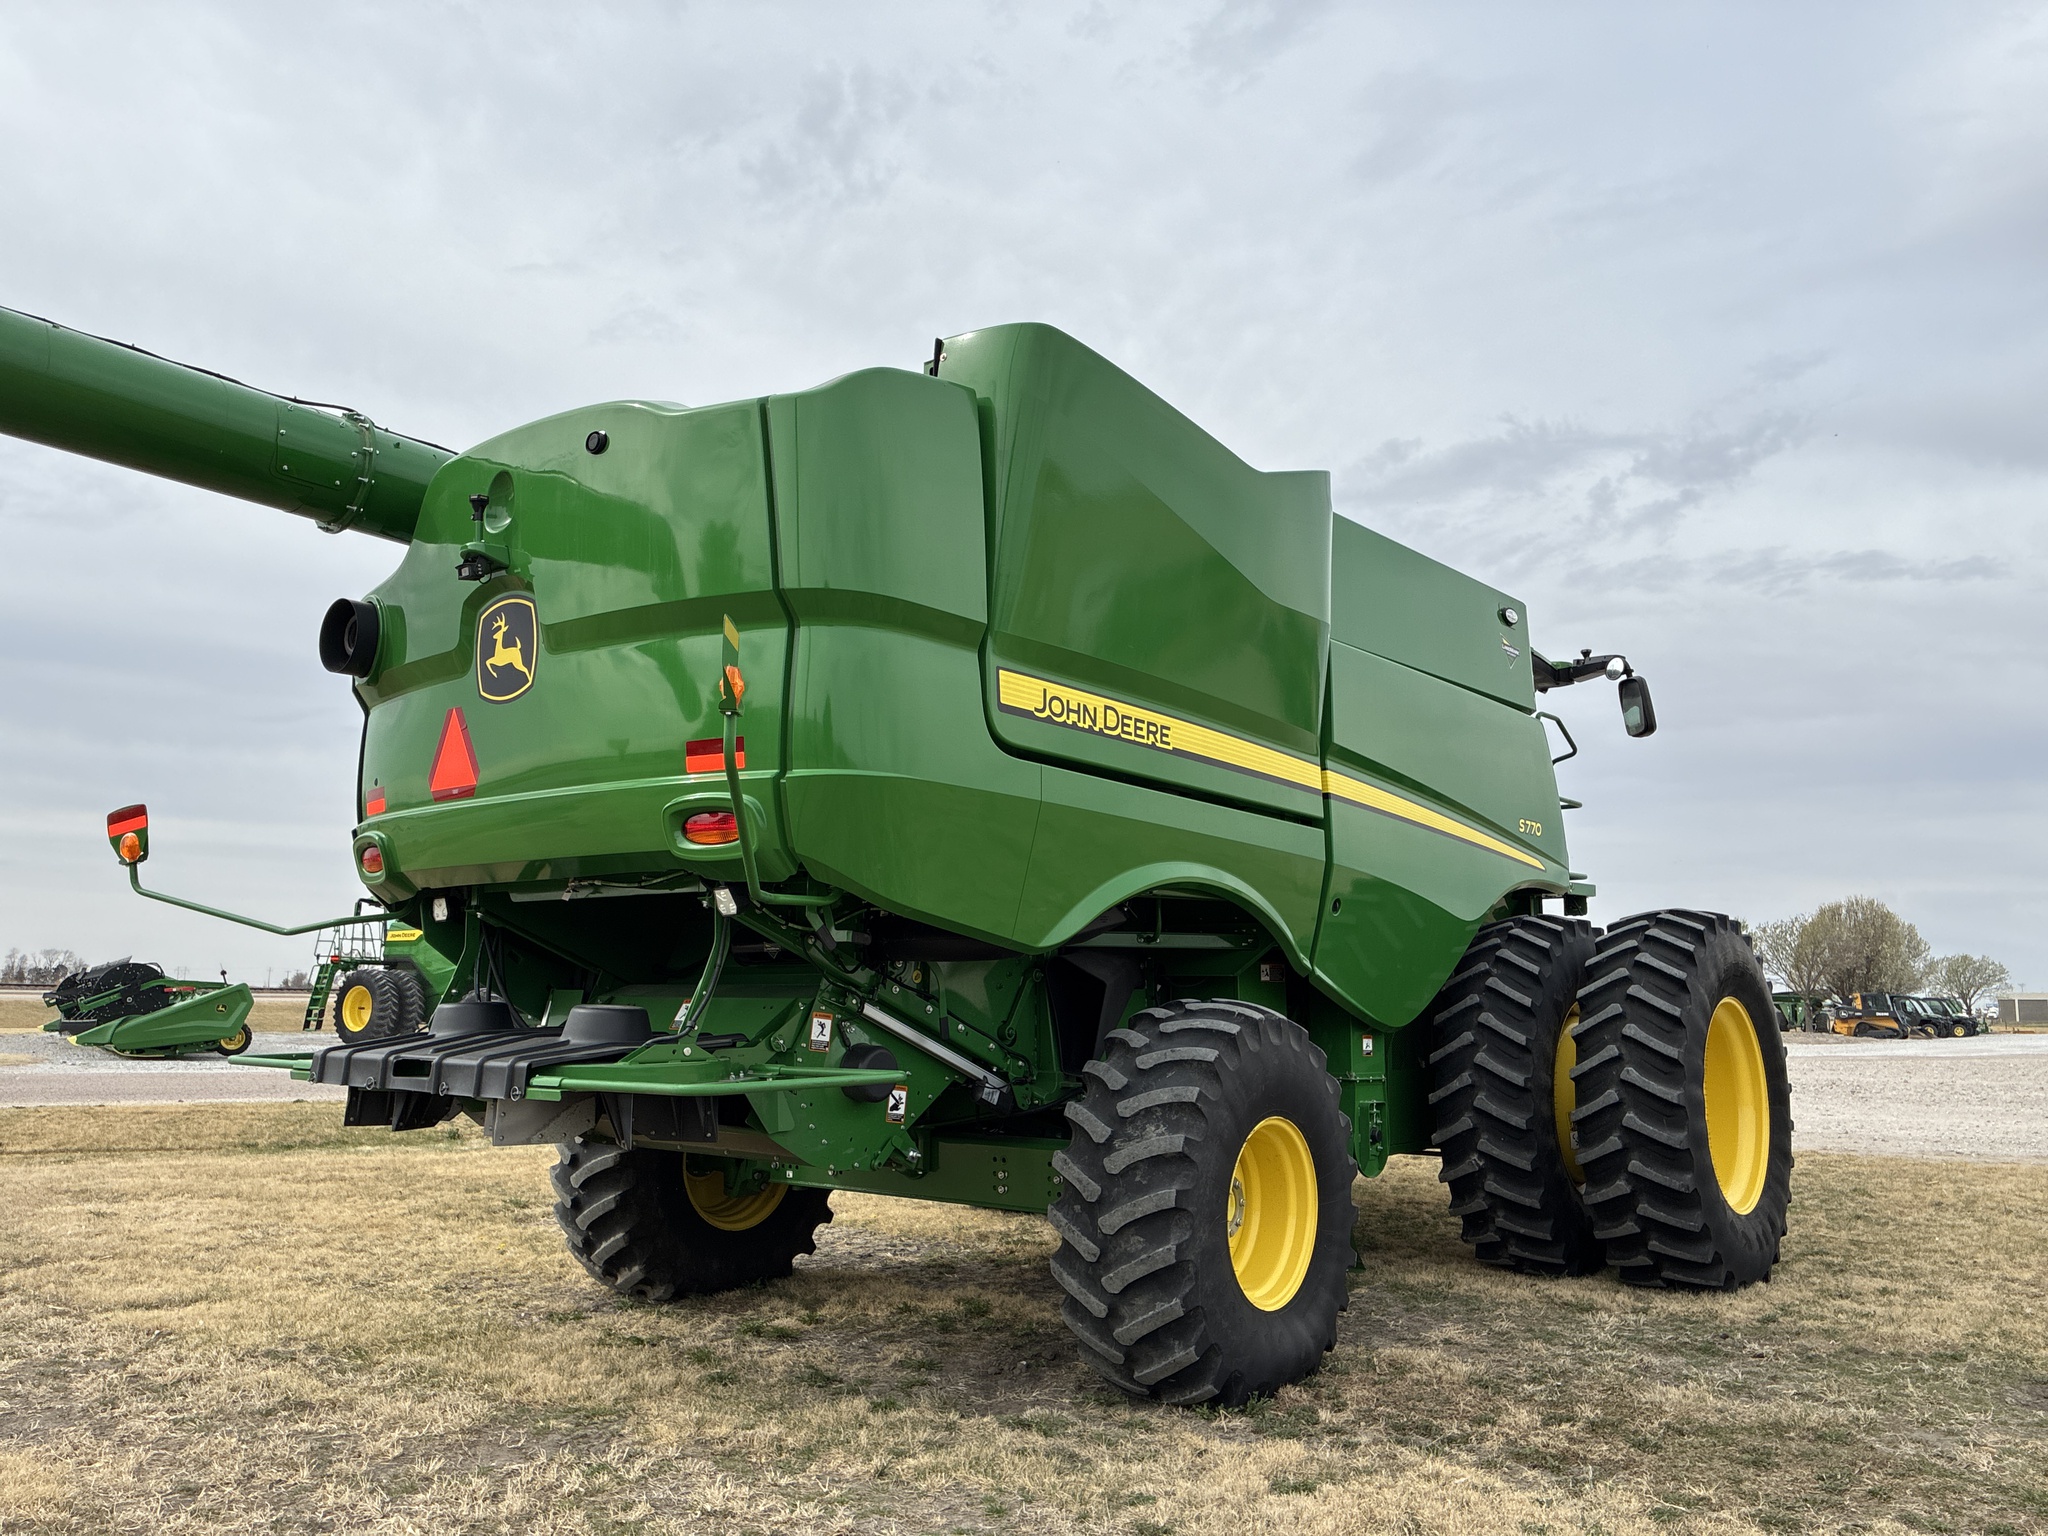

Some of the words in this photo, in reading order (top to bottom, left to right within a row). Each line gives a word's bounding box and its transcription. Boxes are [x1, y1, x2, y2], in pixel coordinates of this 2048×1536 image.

[1034, 688, 1097, 728] JOHN
[1103, 704, 1171, 746] DEERE
[1519, 818, 1542, 837] S770
